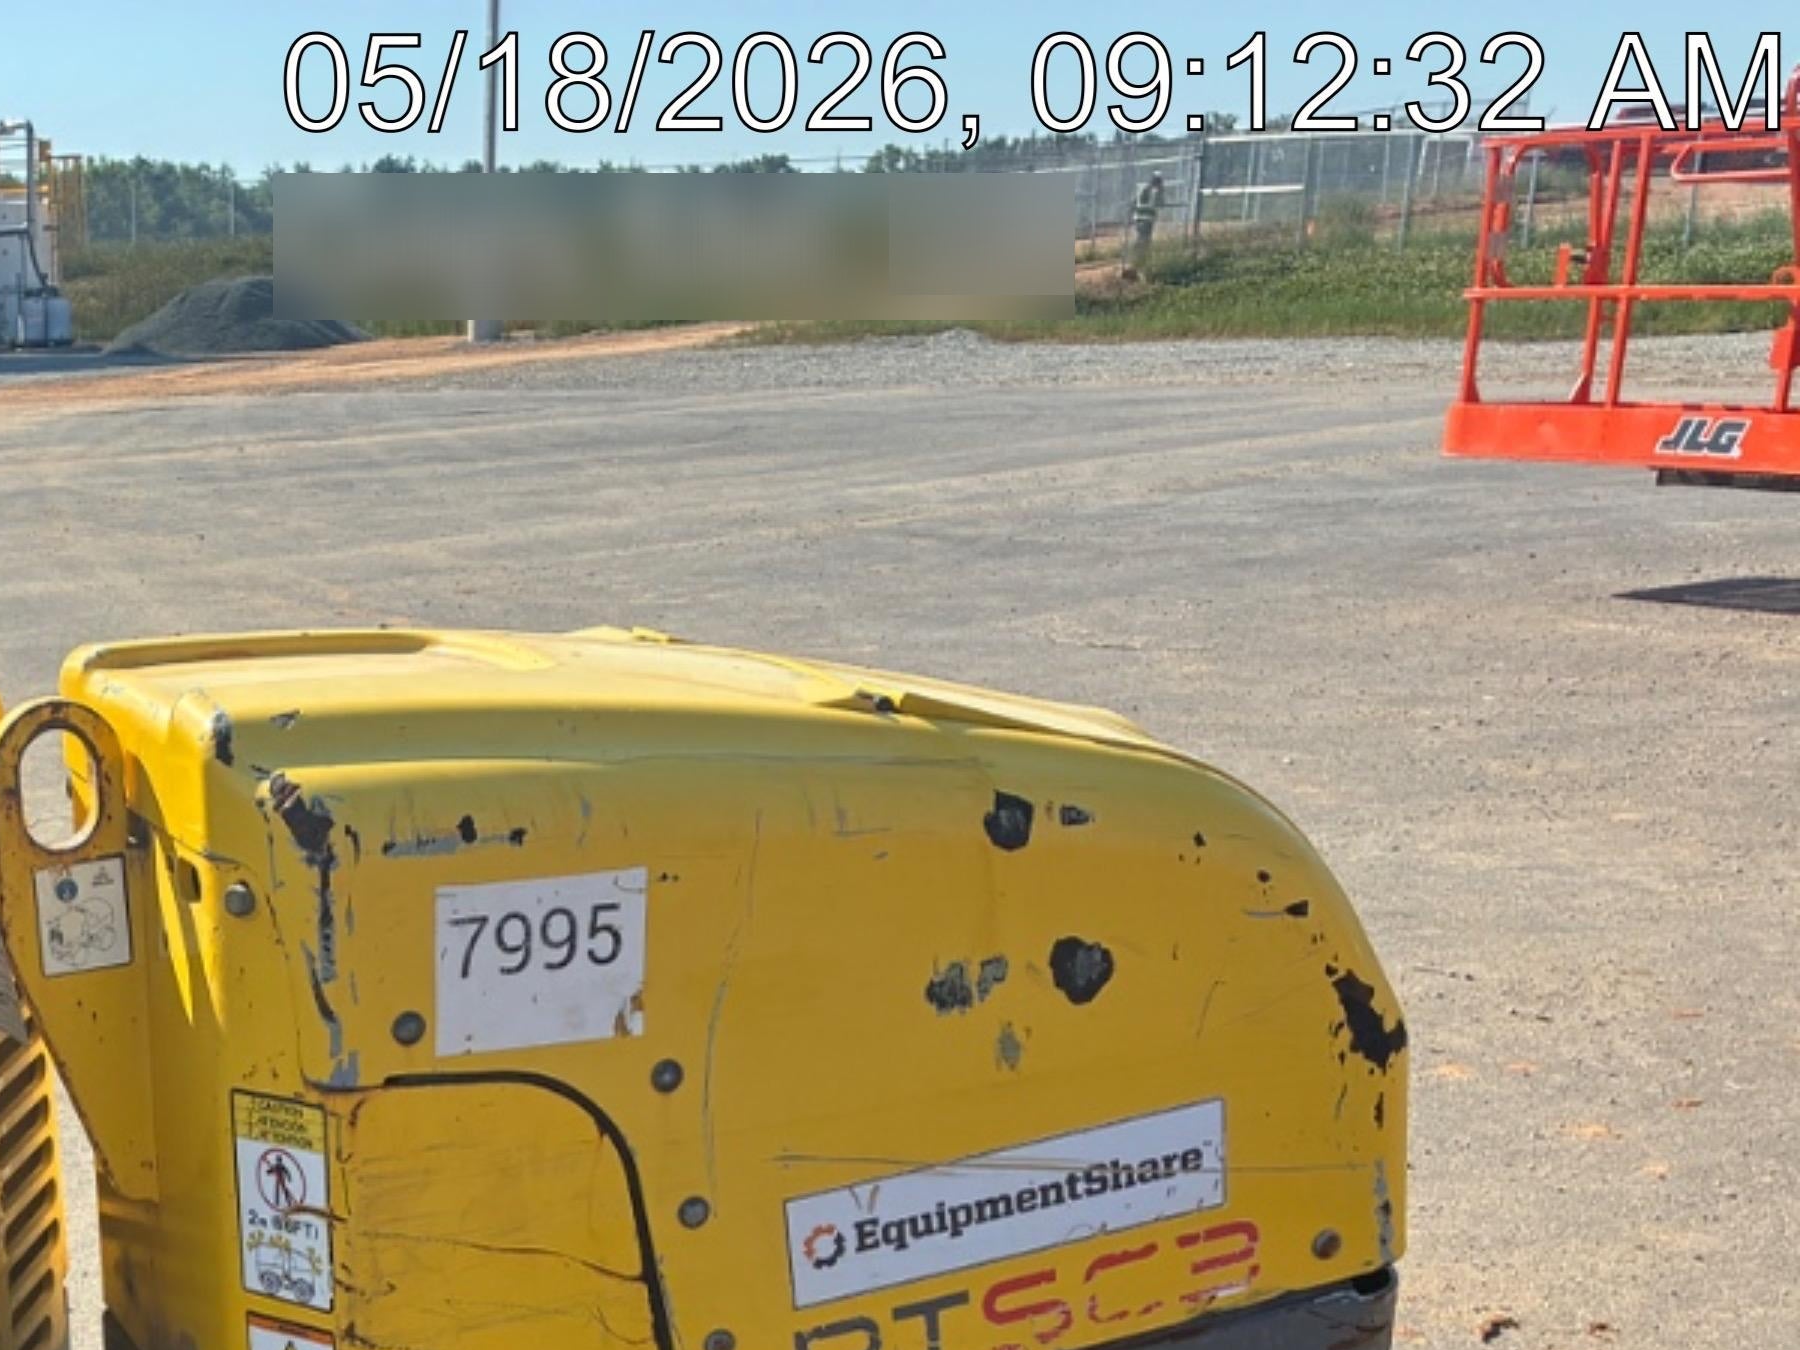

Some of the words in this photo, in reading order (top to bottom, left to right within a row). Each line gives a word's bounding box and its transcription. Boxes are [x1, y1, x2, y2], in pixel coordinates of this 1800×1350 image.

[1656, 417, 1751, 458] JLG
[447, 902, 622, 979] 7995
[853, 1145, 1204, 1253] EquipmentShare
